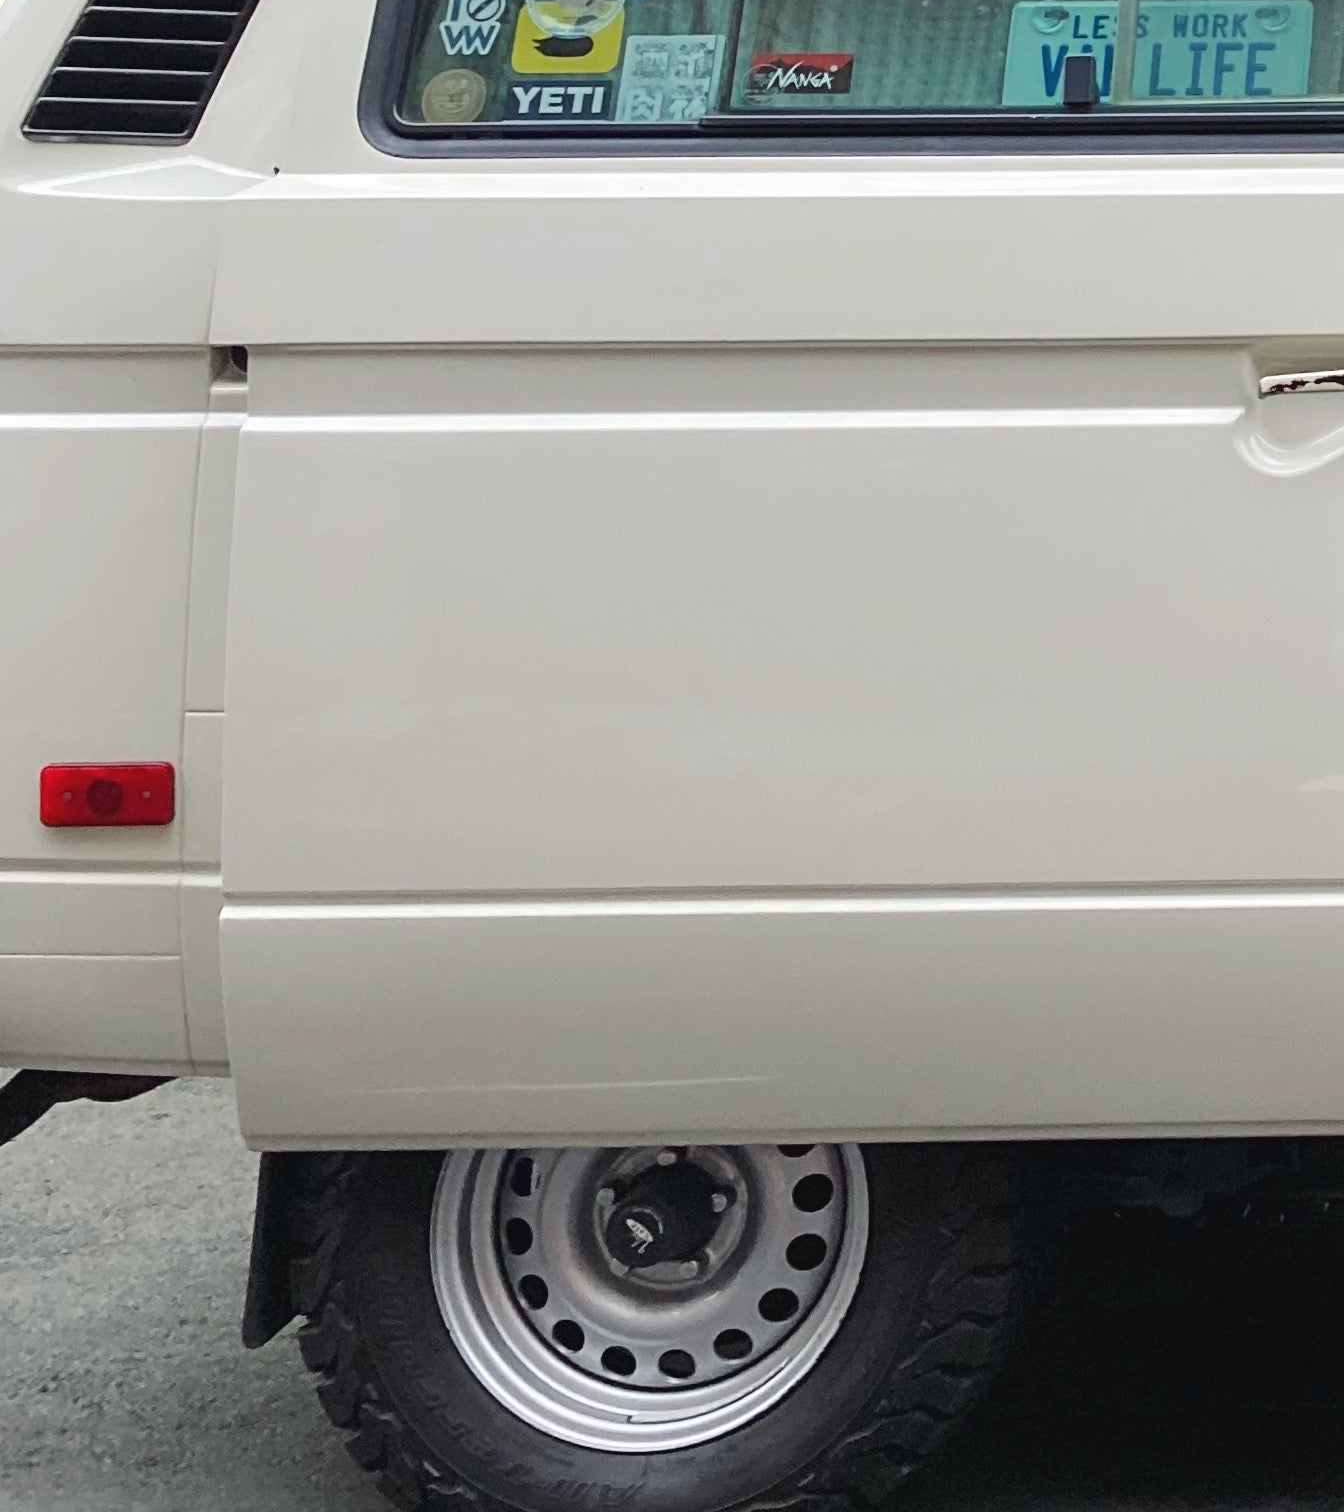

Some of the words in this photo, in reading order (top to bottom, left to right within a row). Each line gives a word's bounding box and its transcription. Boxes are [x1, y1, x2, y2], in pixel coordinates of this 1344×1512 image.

[444, 24, 497, 53] VW
[1072, 14, 1150, 39] LES
[1173, 12, 1249, 39] WORK
[1148, 41, 1276, 96] LIFE
[512, 86, 605, 115] YETI
